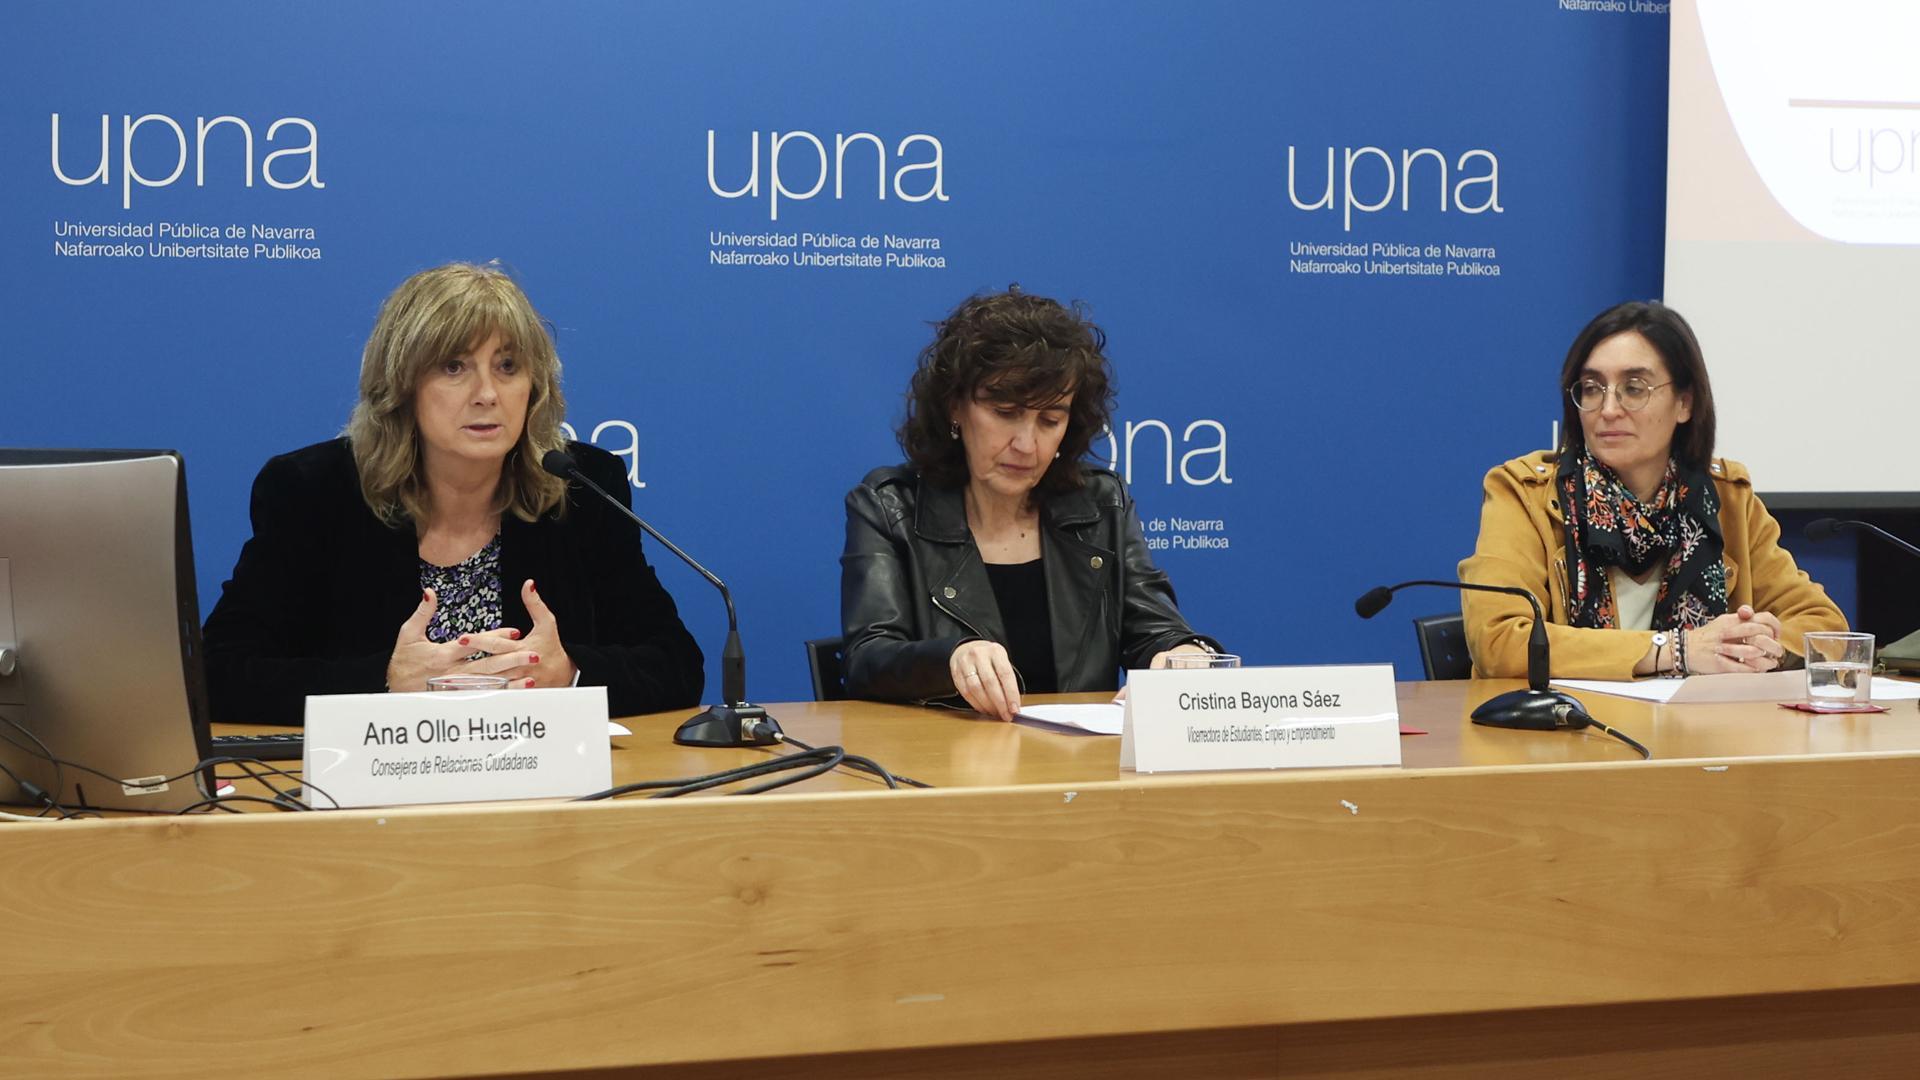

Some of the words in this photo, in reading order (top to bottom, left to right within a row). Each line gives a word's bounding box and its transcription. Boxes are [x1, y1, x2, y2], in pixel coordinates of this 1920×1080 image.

[50, 112, 325, 209] upna
[707, 129, 949, 221] upna
[1287, 145, 1504, 231] upna
[54, 220, 153, 238] Universidad
[159, 222, 220, 239] Pública
[225, 223, 246, 240] de
[251, 224, 315, 240] Navarra
[54, 240, 144, 257] Nafarroako
[149, 242, 249, 259] Unibertsitate
[254, 243, 321, 260] Publikoa
[709, 231, 797, 247] Universidad
[802, 233, 856, 248] Pública
[860, 234, 879, 249] de
[884, 234, 941, 250] Navarra
[1290, 242, 1368, 256] Universidad
[1372, 242, 1420, 257] Pública
[1424, 244, 1441, 258] de
[1445, 245, 1496, 259] Navarra
[709, 250, 789, 266] Nafarroako
[793, 251, 882, 267] Unibertsitate
[886, 253, 946, 268] Publikoa
[1290, 259, 1361, 274] Nafarroako
[1364, 261, 1443, 275] Unibertsitate
[1447, 261, 1500, 276] Publikoa
[1103, 419, 1233, 486] na
[1148, 517, 1167, 532] de
[1170, 517, 1225, 532] Navarra
[1172, 535, 1230, 550] Publikoa
[1178, 691, 1237, 711] Cristina
[1241, 691, 1298, 713] Bayona
[1302, 690, 1341, 708] Sáez
[363, 721, 409, 746] Ana
[416, 719, 460, 744] Ollo
[468, 716, 546, 742] Hualde
[1221, 725, 1229, 743] de
[371, 757, 418, 780] Consejera
[419, 757, 432, 774] de
[433, 754, 483, 774] Relaciones
[485, 752, 538, 772] Ciudadanas
